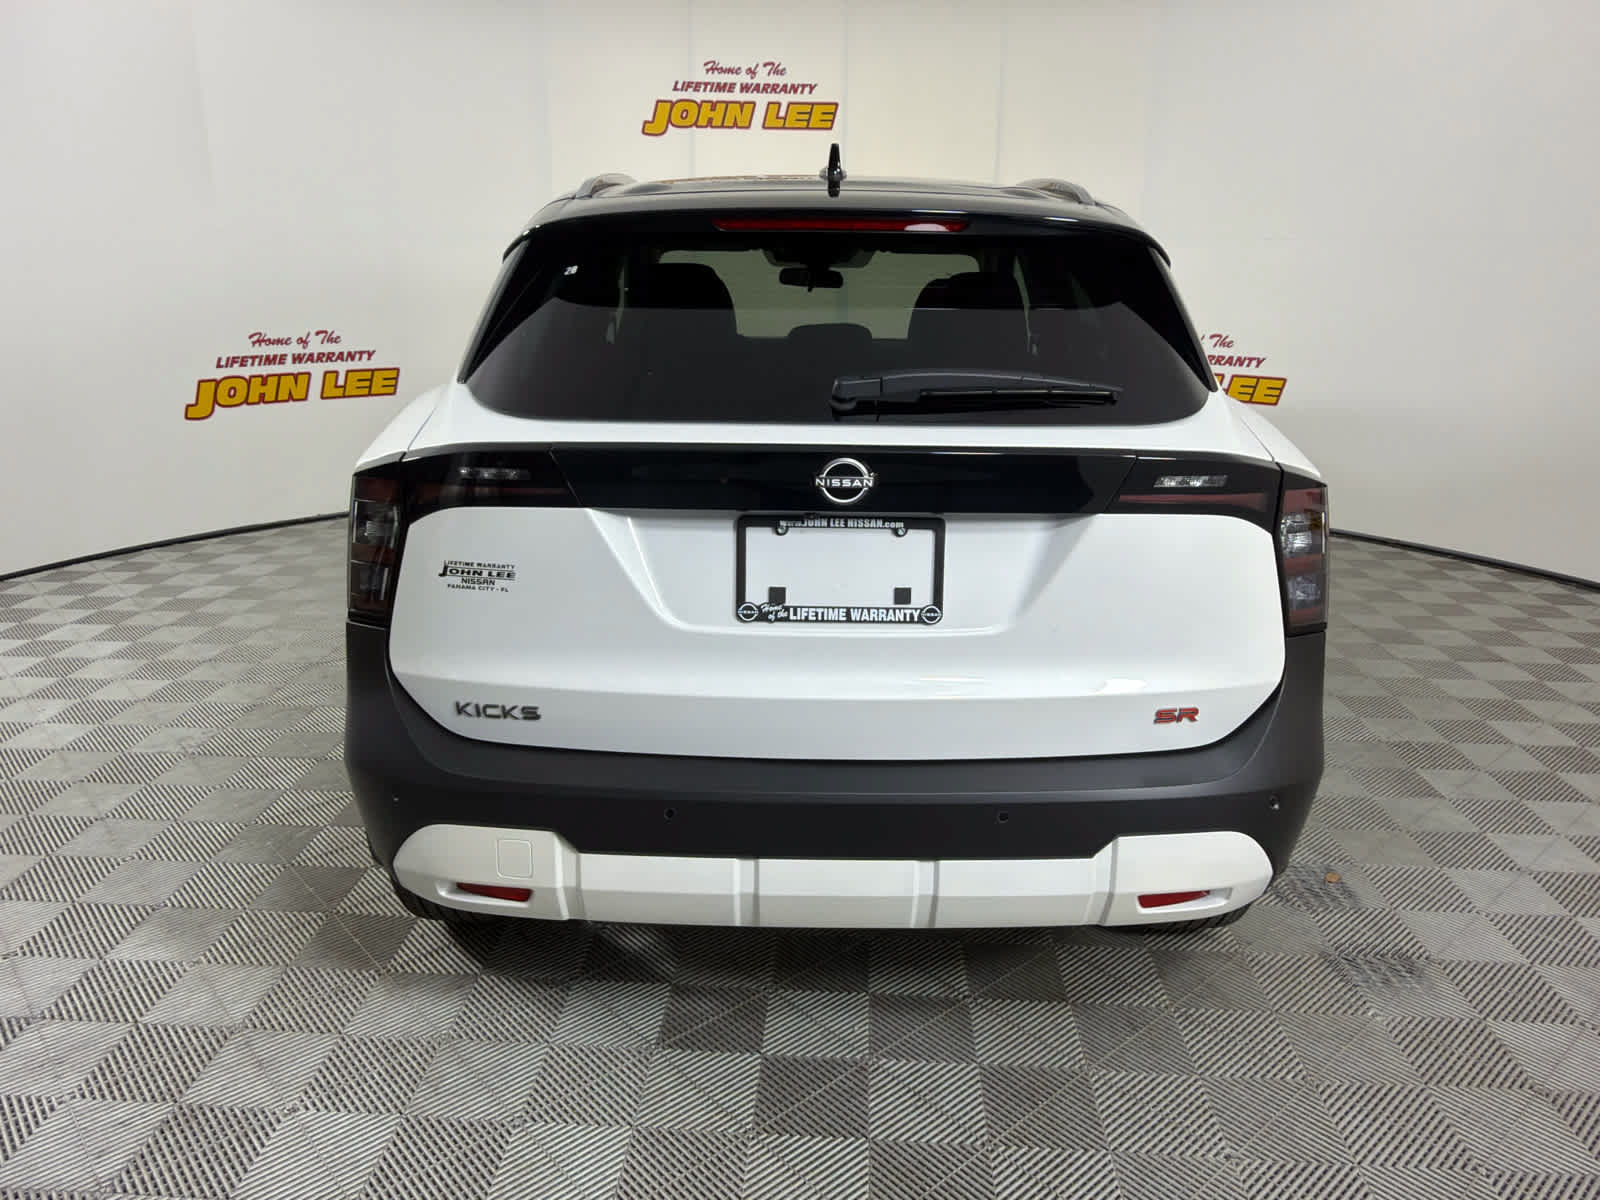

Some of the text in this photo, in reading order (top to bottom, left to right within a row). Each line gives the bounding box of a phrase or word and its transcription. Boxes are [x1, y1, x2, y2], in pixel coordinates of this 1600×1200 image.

[703, 60, 787, 79] Home of The
[672, 80, 818, 95] LIFETIME WARRANTY
[642, 98, 839, 136] JOHN LEE
[248, 329, 342, 349] Home of The
[1209, 333, 1235, 348] The
[215, 349, 376, 369] LIFETIME WARRANTY
[1207, 354, 1267, 368] RRANTY
[184, 367, 400, 421] JOHN LEE
[815, 476, 874, 488] NISSAN
[829, 518, 846, 528] LEE
[438, 560, 516, 579] JOHN LEE
[461, 577, 496, 586] NISSAN
[789, 607, 921, 621] LIFETIME WARRANTY
[455, 701, 541, 721] KICKS
[1153, 706, 1199, 724] SR
